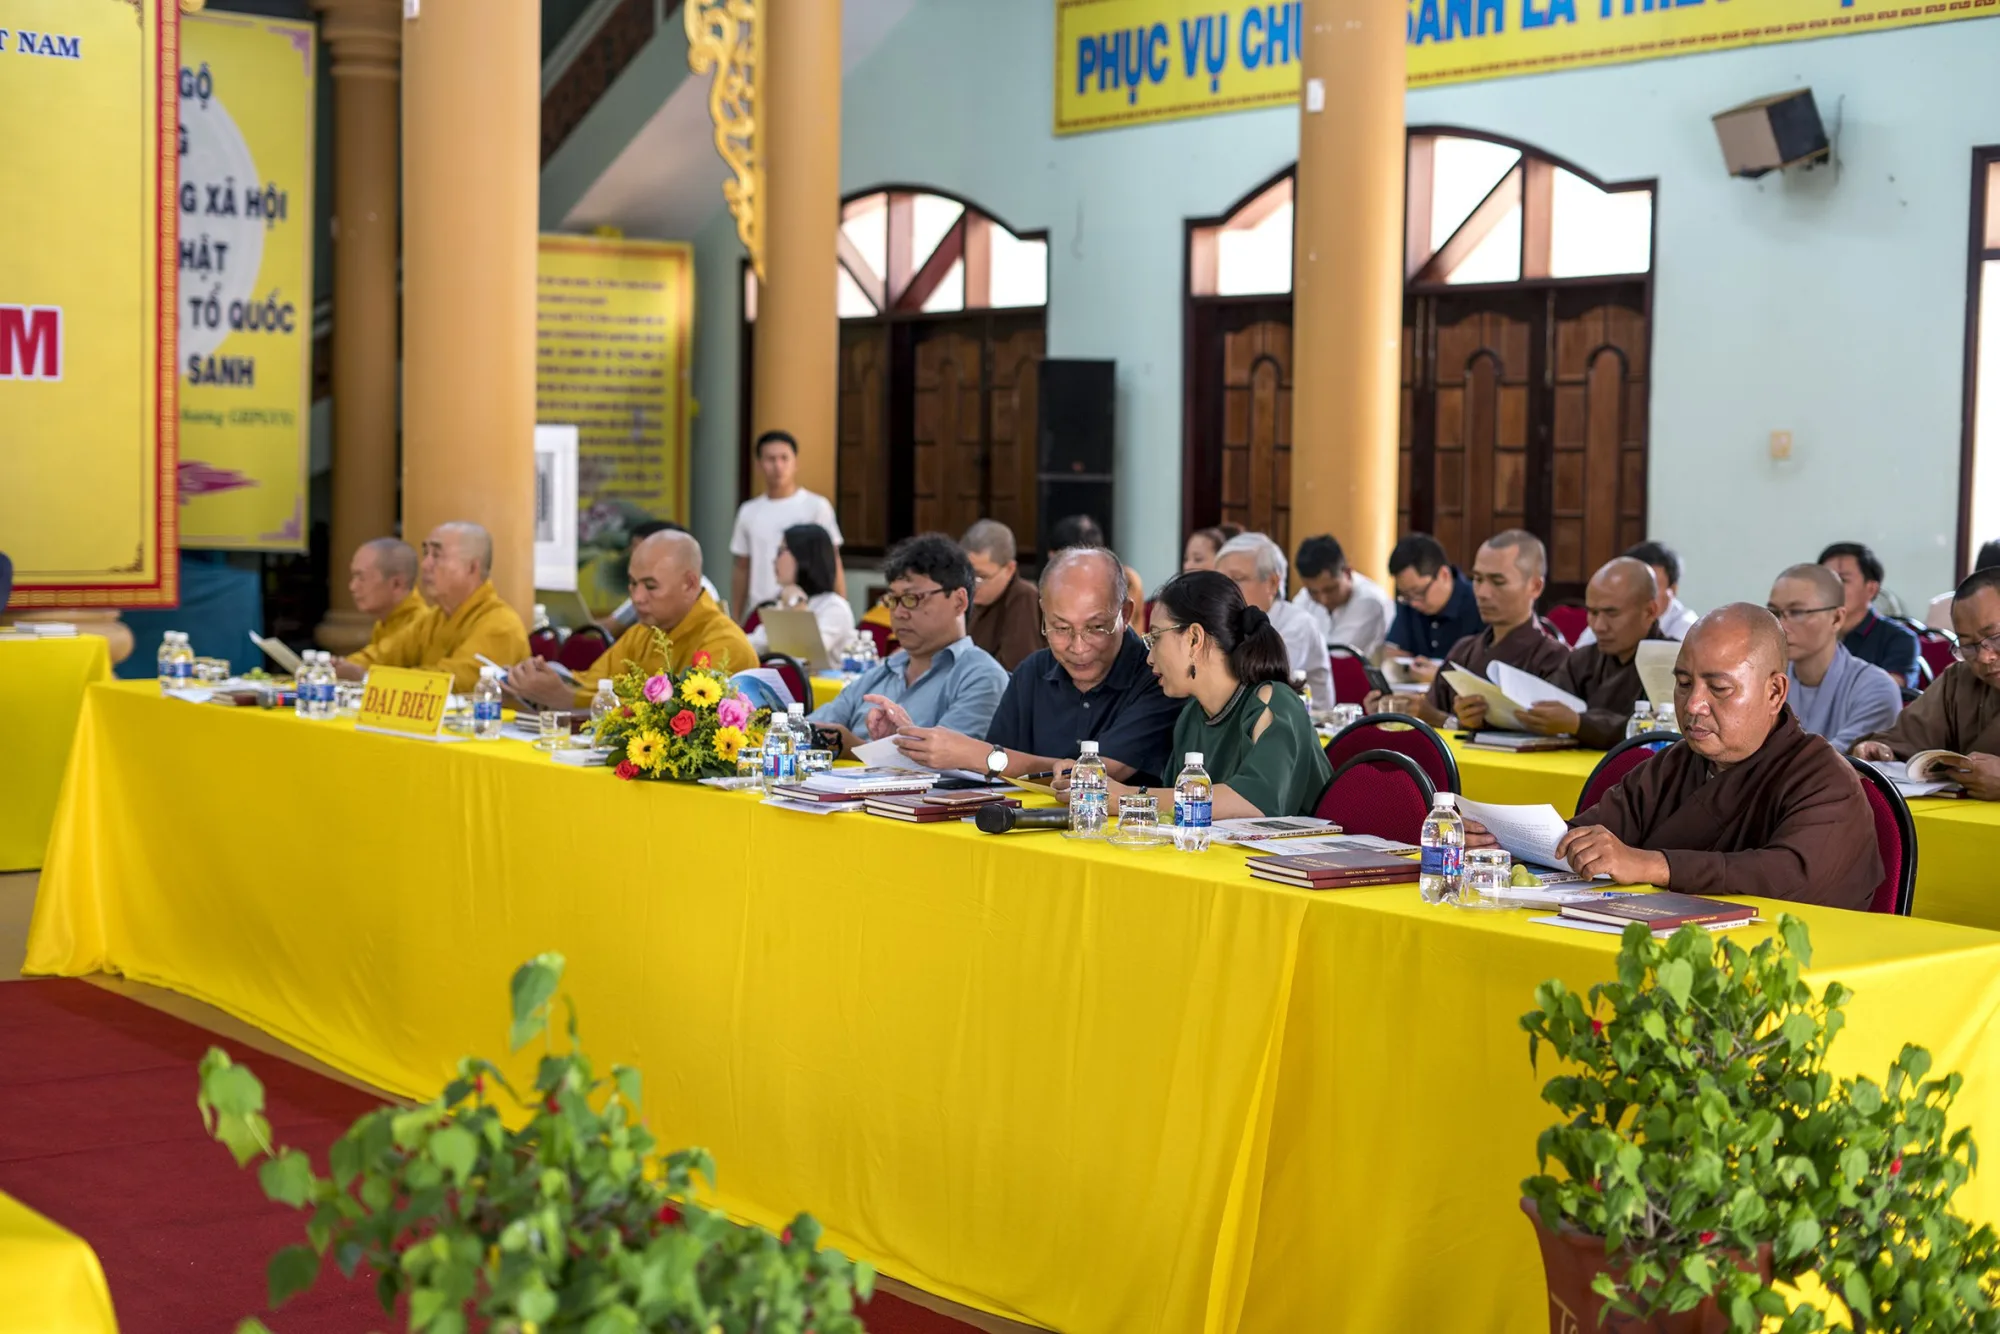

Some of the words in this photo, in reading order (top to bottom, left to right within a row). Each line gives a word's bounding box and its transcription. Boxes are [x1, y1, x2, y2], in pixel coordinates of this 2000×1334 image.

[17, 31, 80, 58] NAM
[1077, 22, 1169, 106] PHỤC
[1180, 14, 1228, 93] VỤ
[246, 183, 288, 229] HỘI
[189, 282, 222, 331] TỔ
[228, 287, 294, 335] QUỐC
[0, 306, 60, 378] M
[188, 353, 254, 389] SANH
[363, 686, 397, 721] ĐẠI
[398, 679, 442, 723] BIỂU
